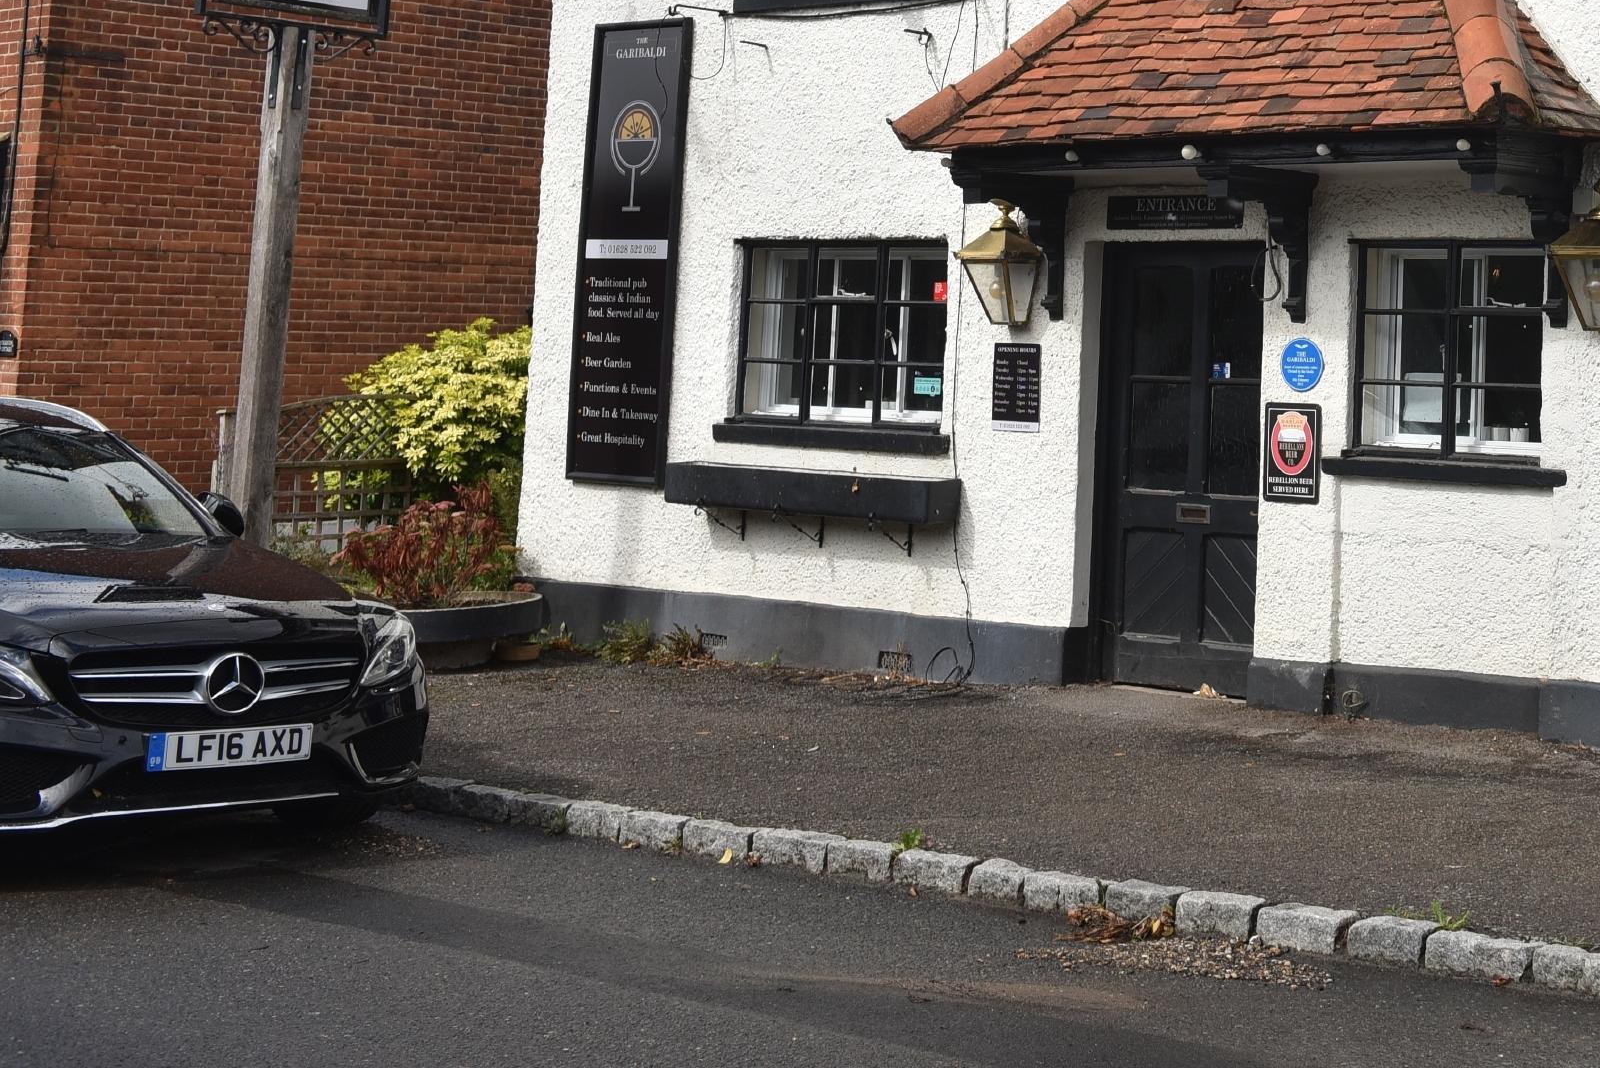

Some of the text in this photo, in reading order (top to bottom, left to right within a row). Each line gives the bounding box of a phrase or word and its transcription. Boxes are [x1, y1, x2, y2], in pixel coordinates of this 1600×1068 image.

[616, 47, 666, 59] GARIBALDI
[1136, 196, 1217, 212] ENTRANCE
[600, 244, 657, 254] T: 01628 522 092
[632, 278, 647, 289] pub
[588, 293, 651, 304] classics & Indian
[606, 307, 633, 319] Served
[634, 308, 645, 319] all
[646, 309, 659, 321] day
[586, 332, 621, 343] Real Ales
[585, 356, 632, 369] Beer Garden
[583, 381, 657, 395] Functions & Events
[582, 406, 659, 422] Dine In & Takeaway
[581, 432, 645, 446] Great Hospitality
[1268, 476, 1314, 485] REBELLION BEER
[1272, 485, 1310, 494] SERVED HERE
[175, 728, 304, 764] LF16 AXD
